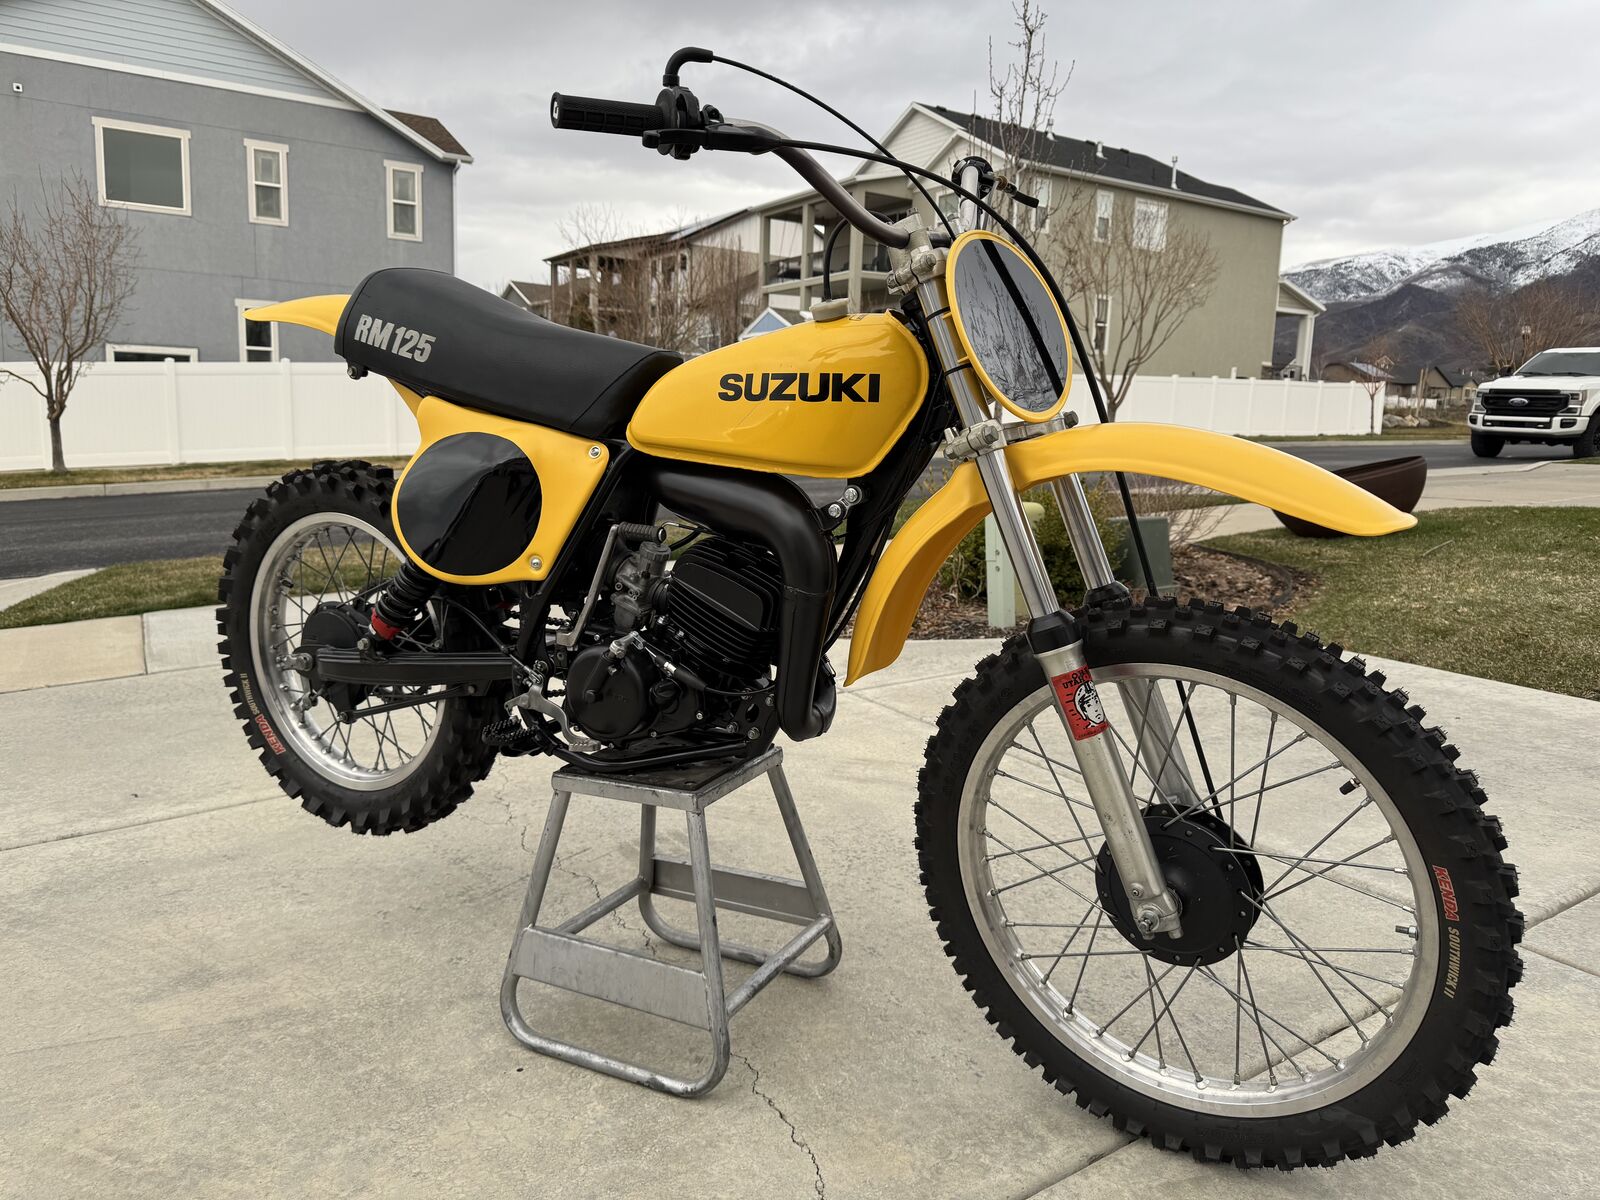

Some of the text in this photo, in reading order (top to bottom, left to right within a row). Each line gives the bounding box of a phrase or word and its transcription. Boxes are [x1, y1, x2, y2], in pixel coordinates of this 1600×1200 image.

[354, 314, 437, 363] RM125
[718, 373, 881, 403] SUZUKI
[255, 713, 286, 755] KENDA
[1432, 864, 1460, 922] KENDA
[1445, 926, 1461, 991] SOUTHWICK
